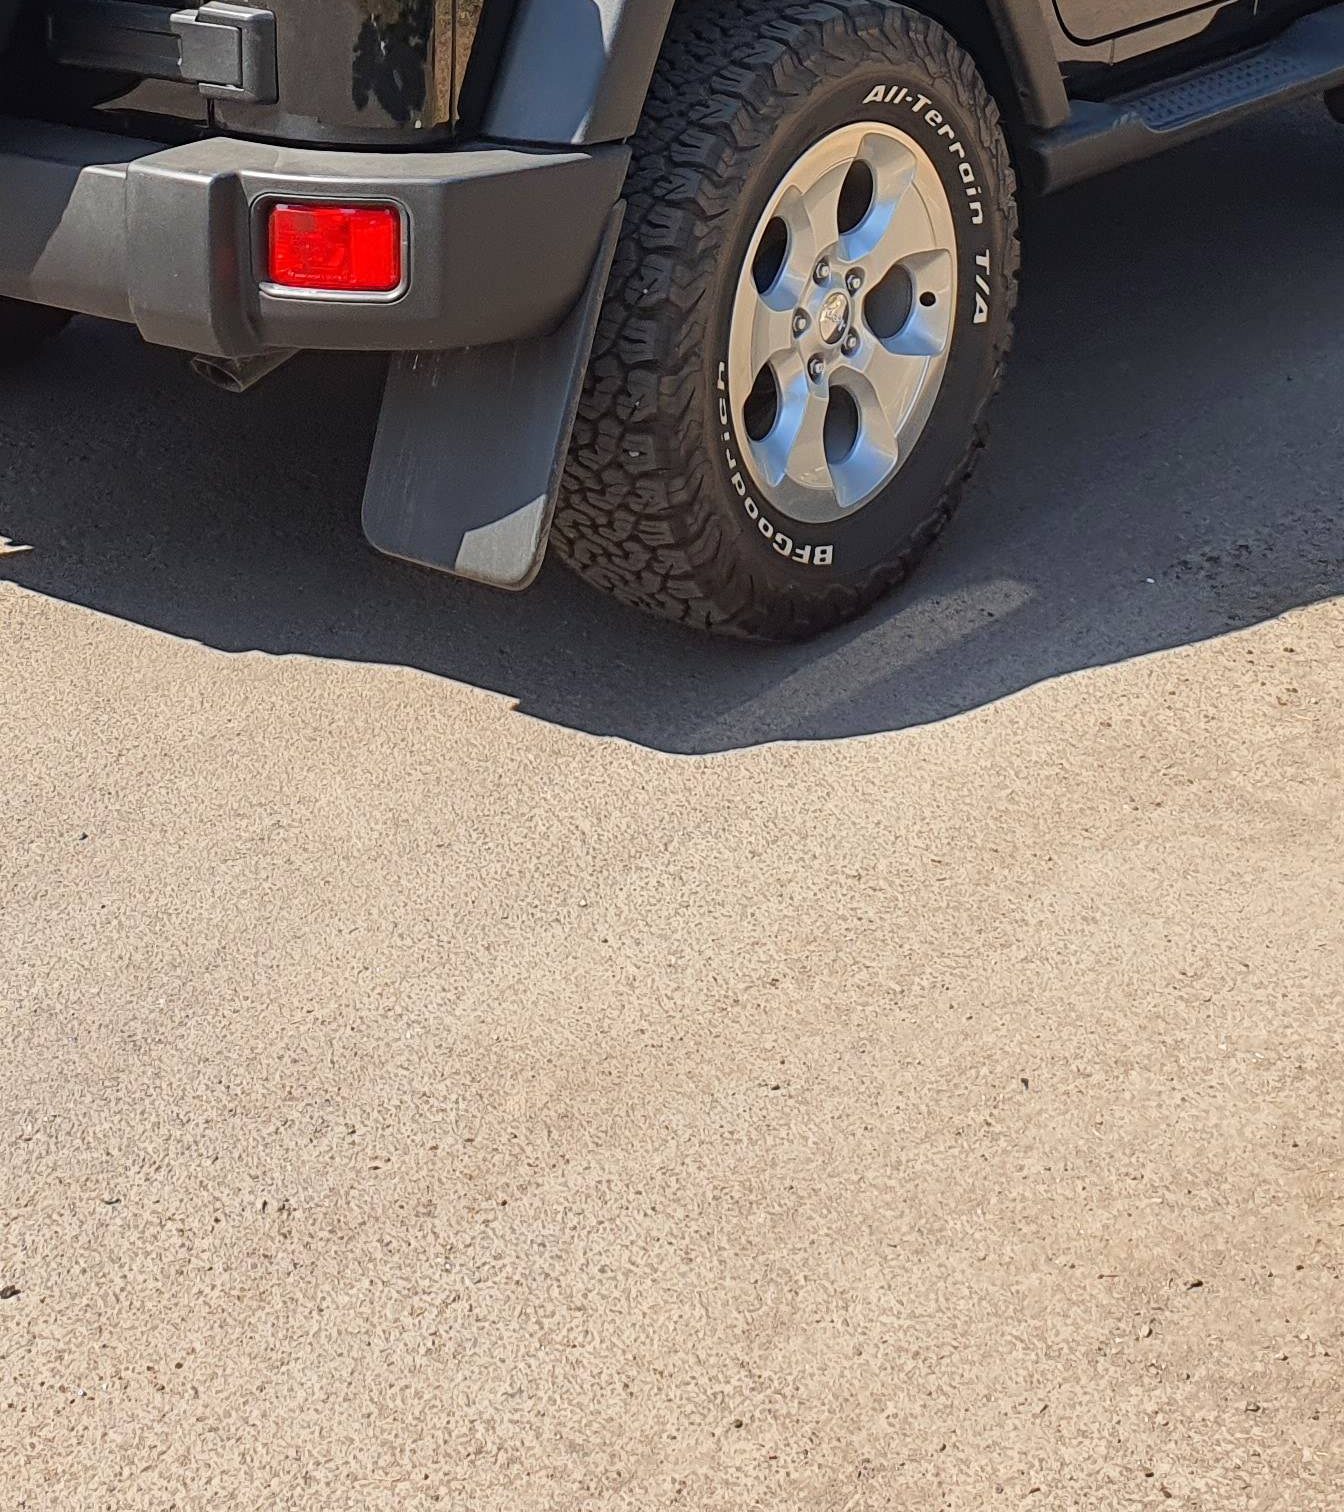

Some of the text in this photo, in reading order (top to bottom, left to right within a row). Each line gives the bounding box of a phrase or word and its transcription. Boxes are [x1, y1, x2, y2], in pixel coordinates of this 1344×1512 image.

[862, 83, 992, 326] All-Terrain T/A
[716, 361, 835, 567] BFGoodrich
